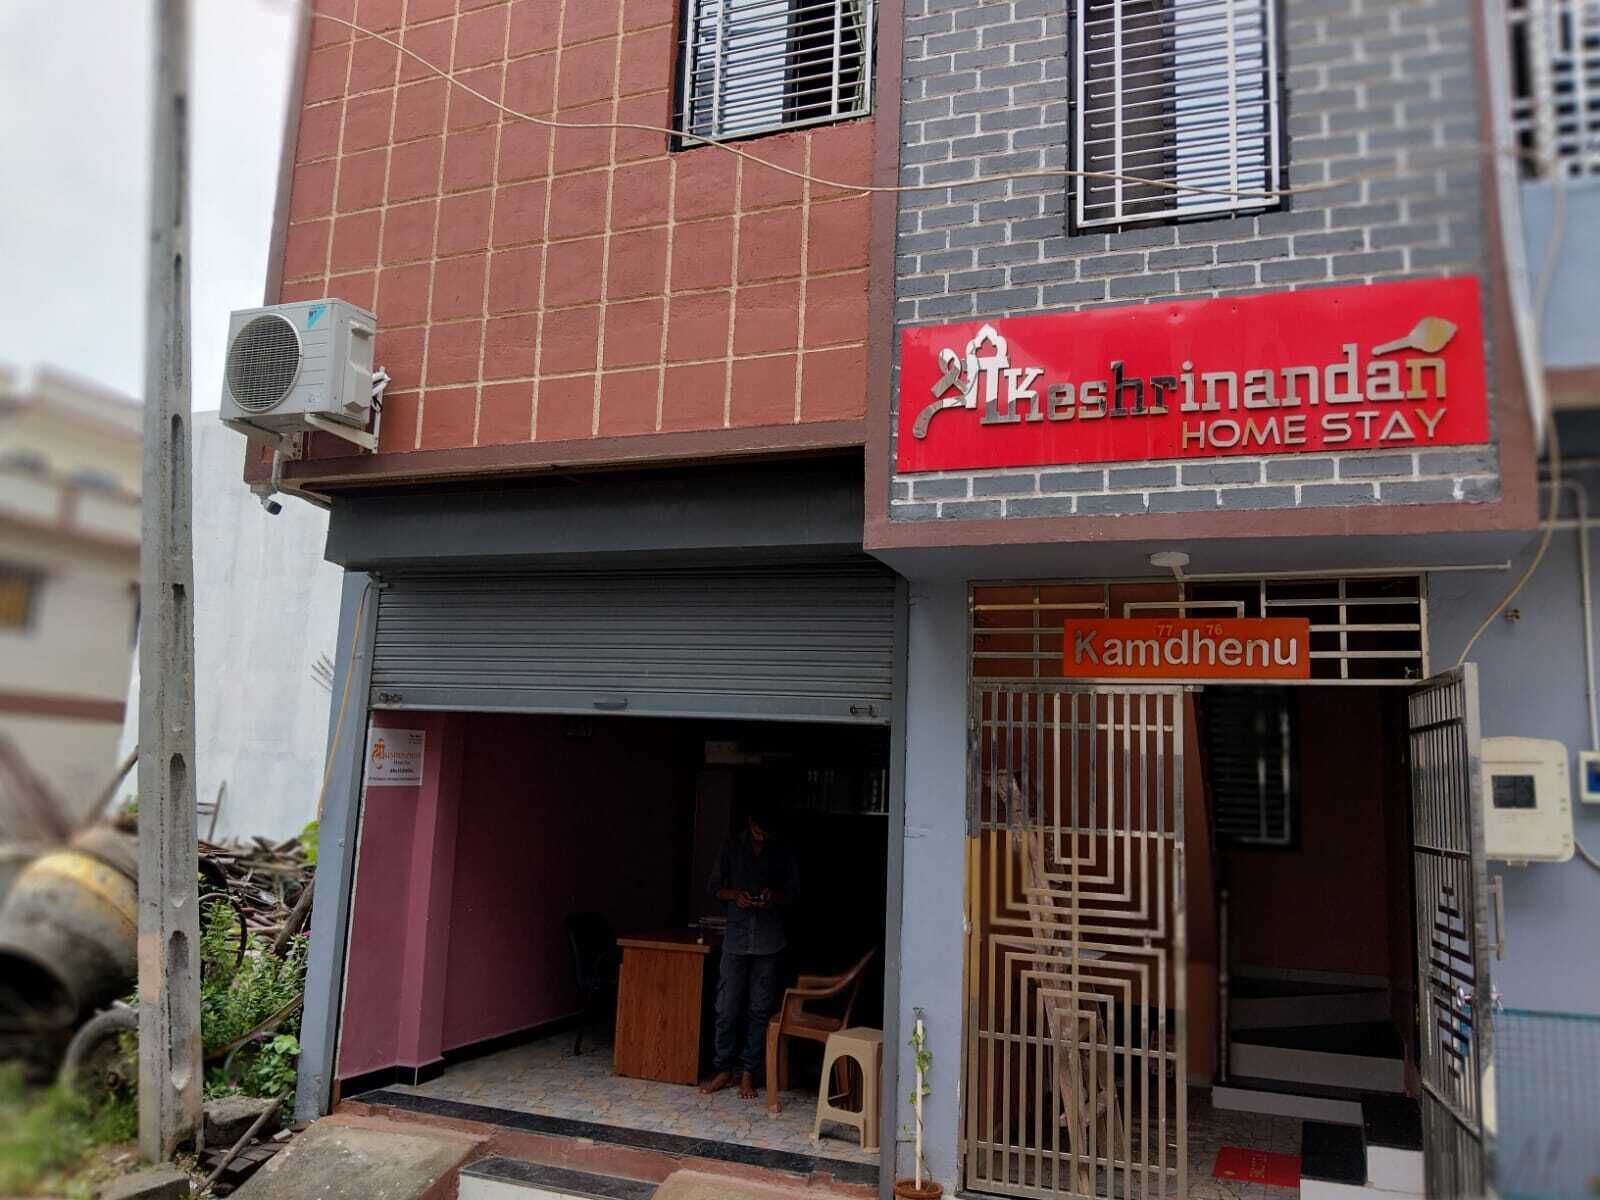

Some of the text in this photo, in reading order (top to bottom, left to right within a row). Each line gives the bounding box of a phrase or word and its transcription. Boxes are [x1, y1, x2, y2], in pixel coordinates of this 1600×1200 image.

[1182, 407, 1447, 448] HOME STAY
[1074, 628, 1297, 667] Kamdhenu
[1158, 624, 1223, 636] 77 76
